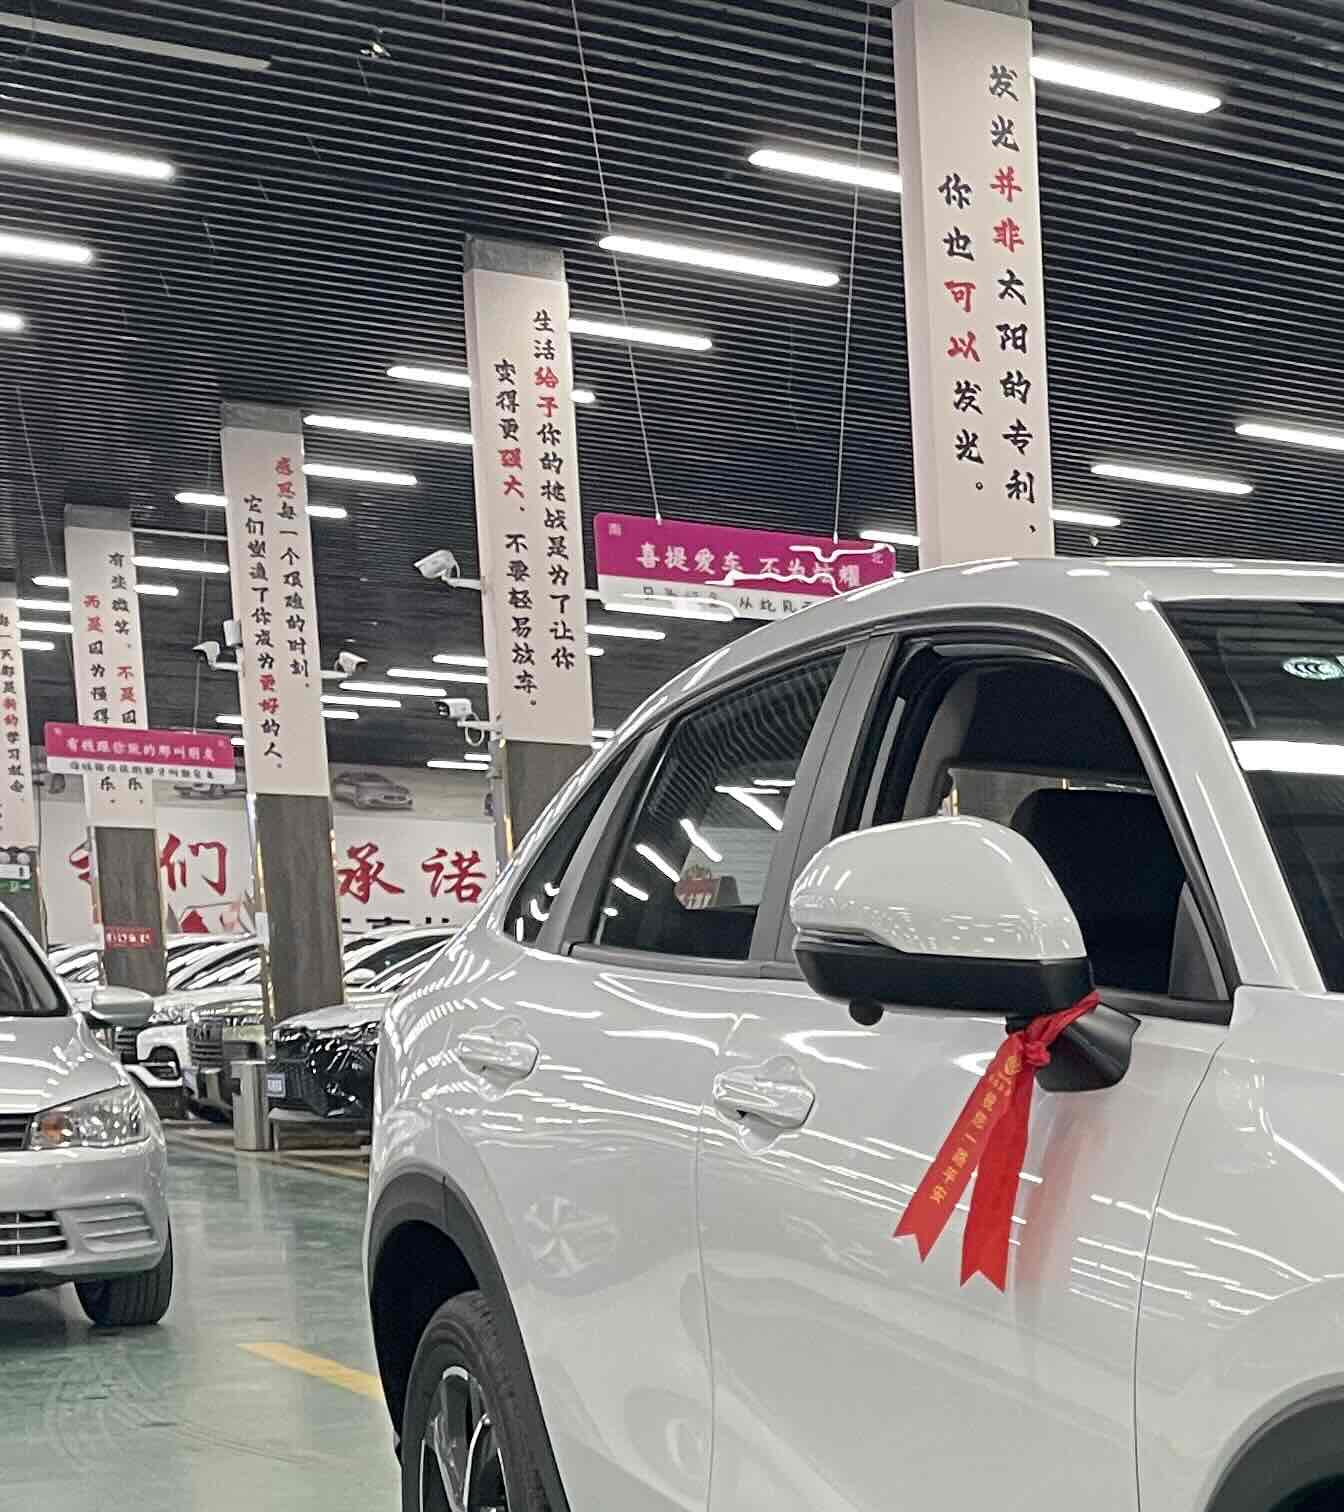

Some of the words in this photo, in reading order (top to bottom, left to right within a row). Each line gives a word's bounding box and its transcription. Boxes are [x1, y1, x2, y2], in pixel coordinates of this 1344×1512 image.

[532, 309, 576, 670] 生活给予你的挑战是为了让你
[938, 172, 985, 491] 你也可以发光。
